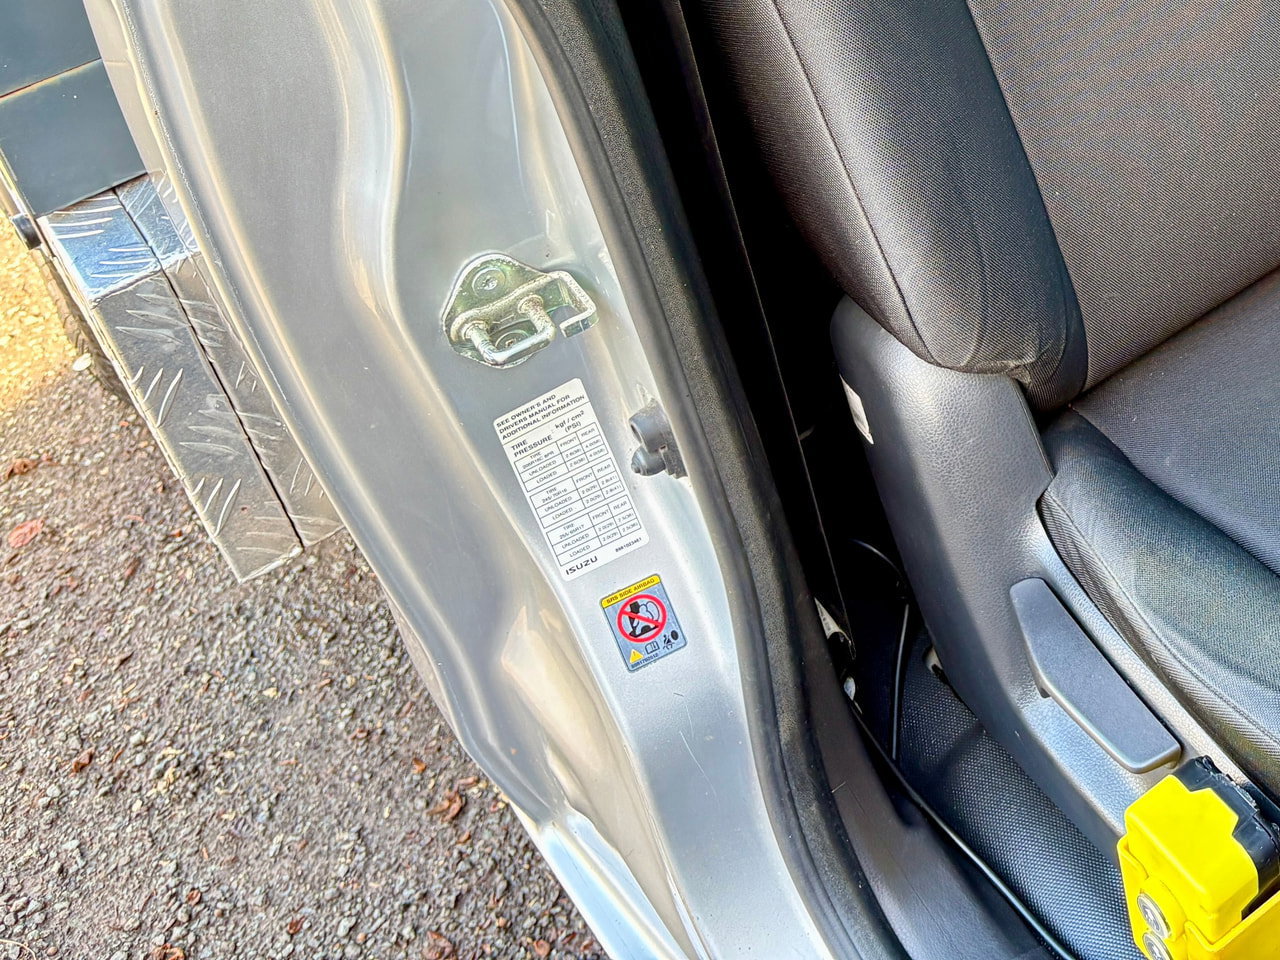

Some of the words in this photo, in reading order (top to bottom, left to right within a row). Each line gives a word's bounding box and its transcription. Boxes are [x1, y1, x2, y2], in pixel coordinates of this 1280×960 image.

[497, 418, 510, 428] SEE
[542, 394, 556, 404] AND
[512, 440, 528, 451] TIRE
[514, 435, 553, 457] PRESSURE
[565, 556, 598, 575] ISUZU
